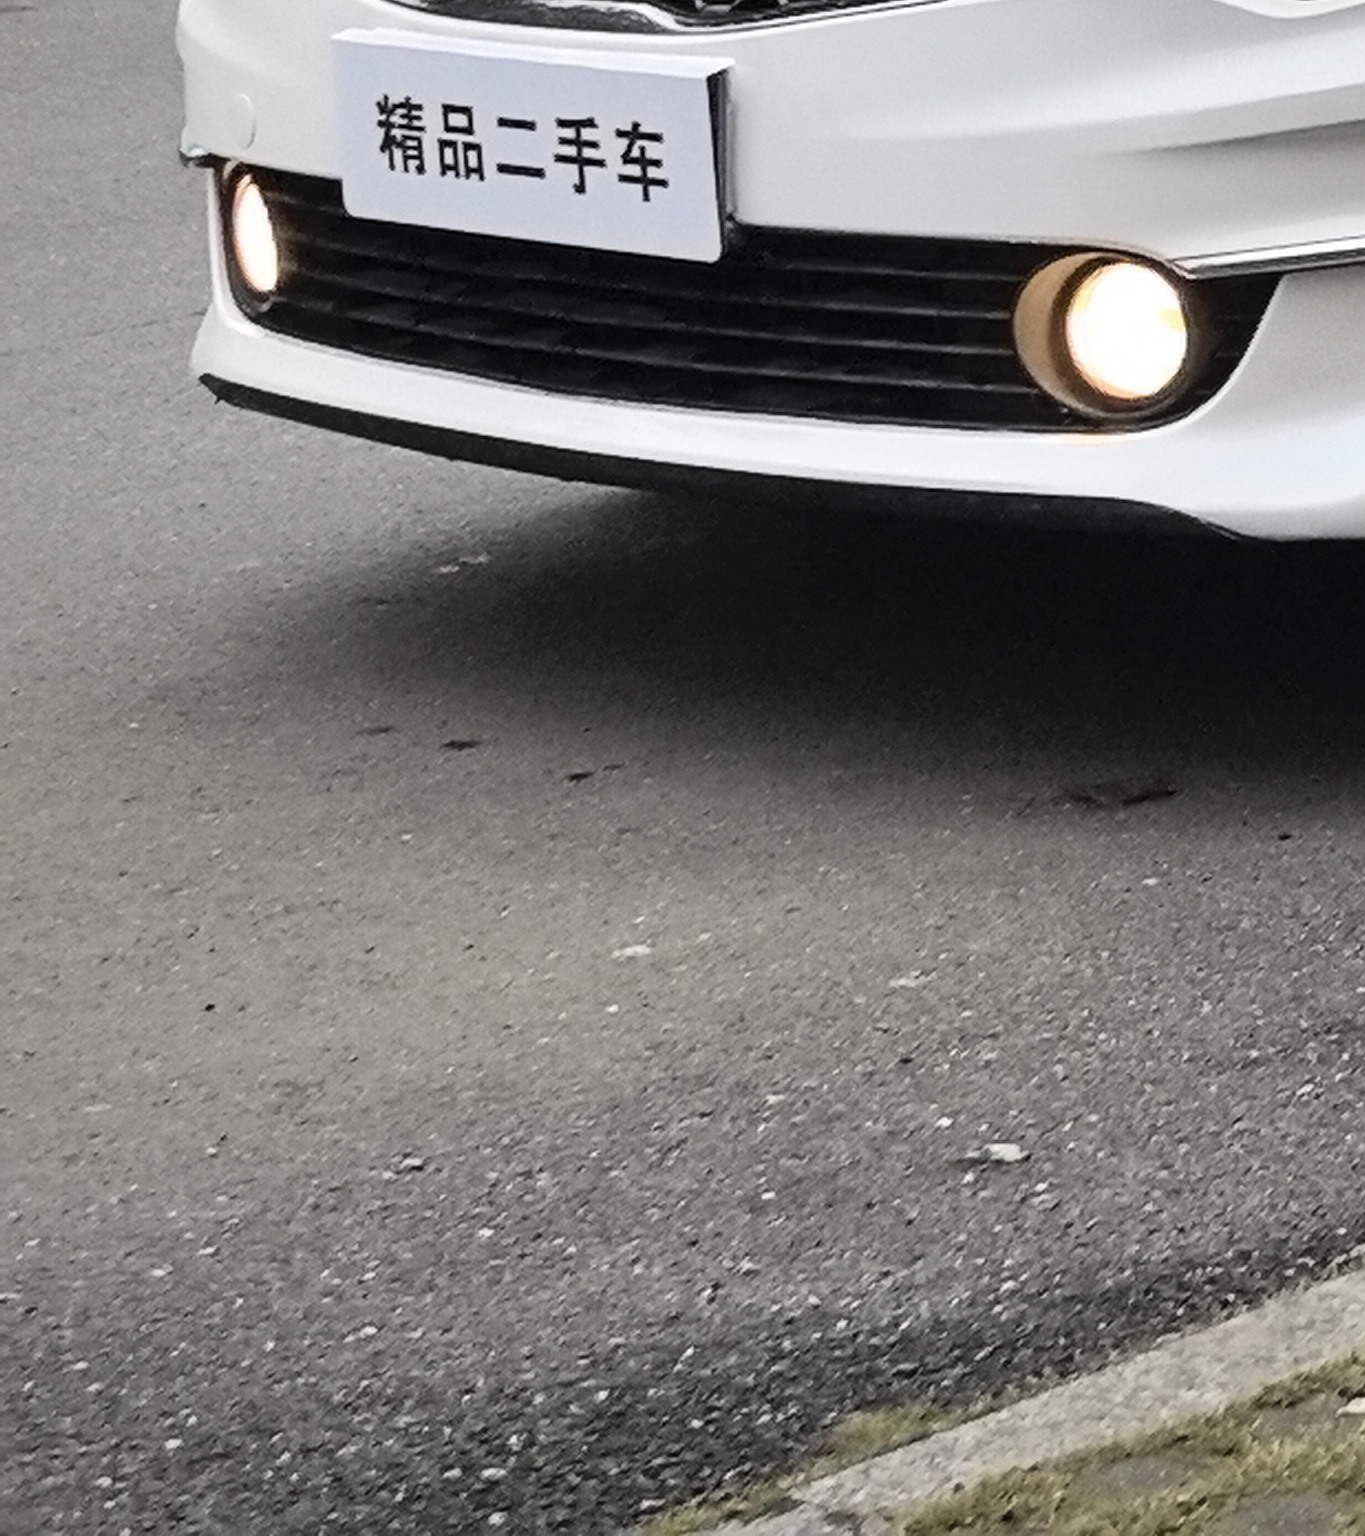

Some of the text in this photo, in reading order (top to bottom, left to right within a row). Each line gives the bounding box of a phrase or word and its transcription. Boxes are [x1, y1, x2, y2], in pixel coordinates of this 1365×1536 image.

[375, 94, 670, 202] 精品二手车
